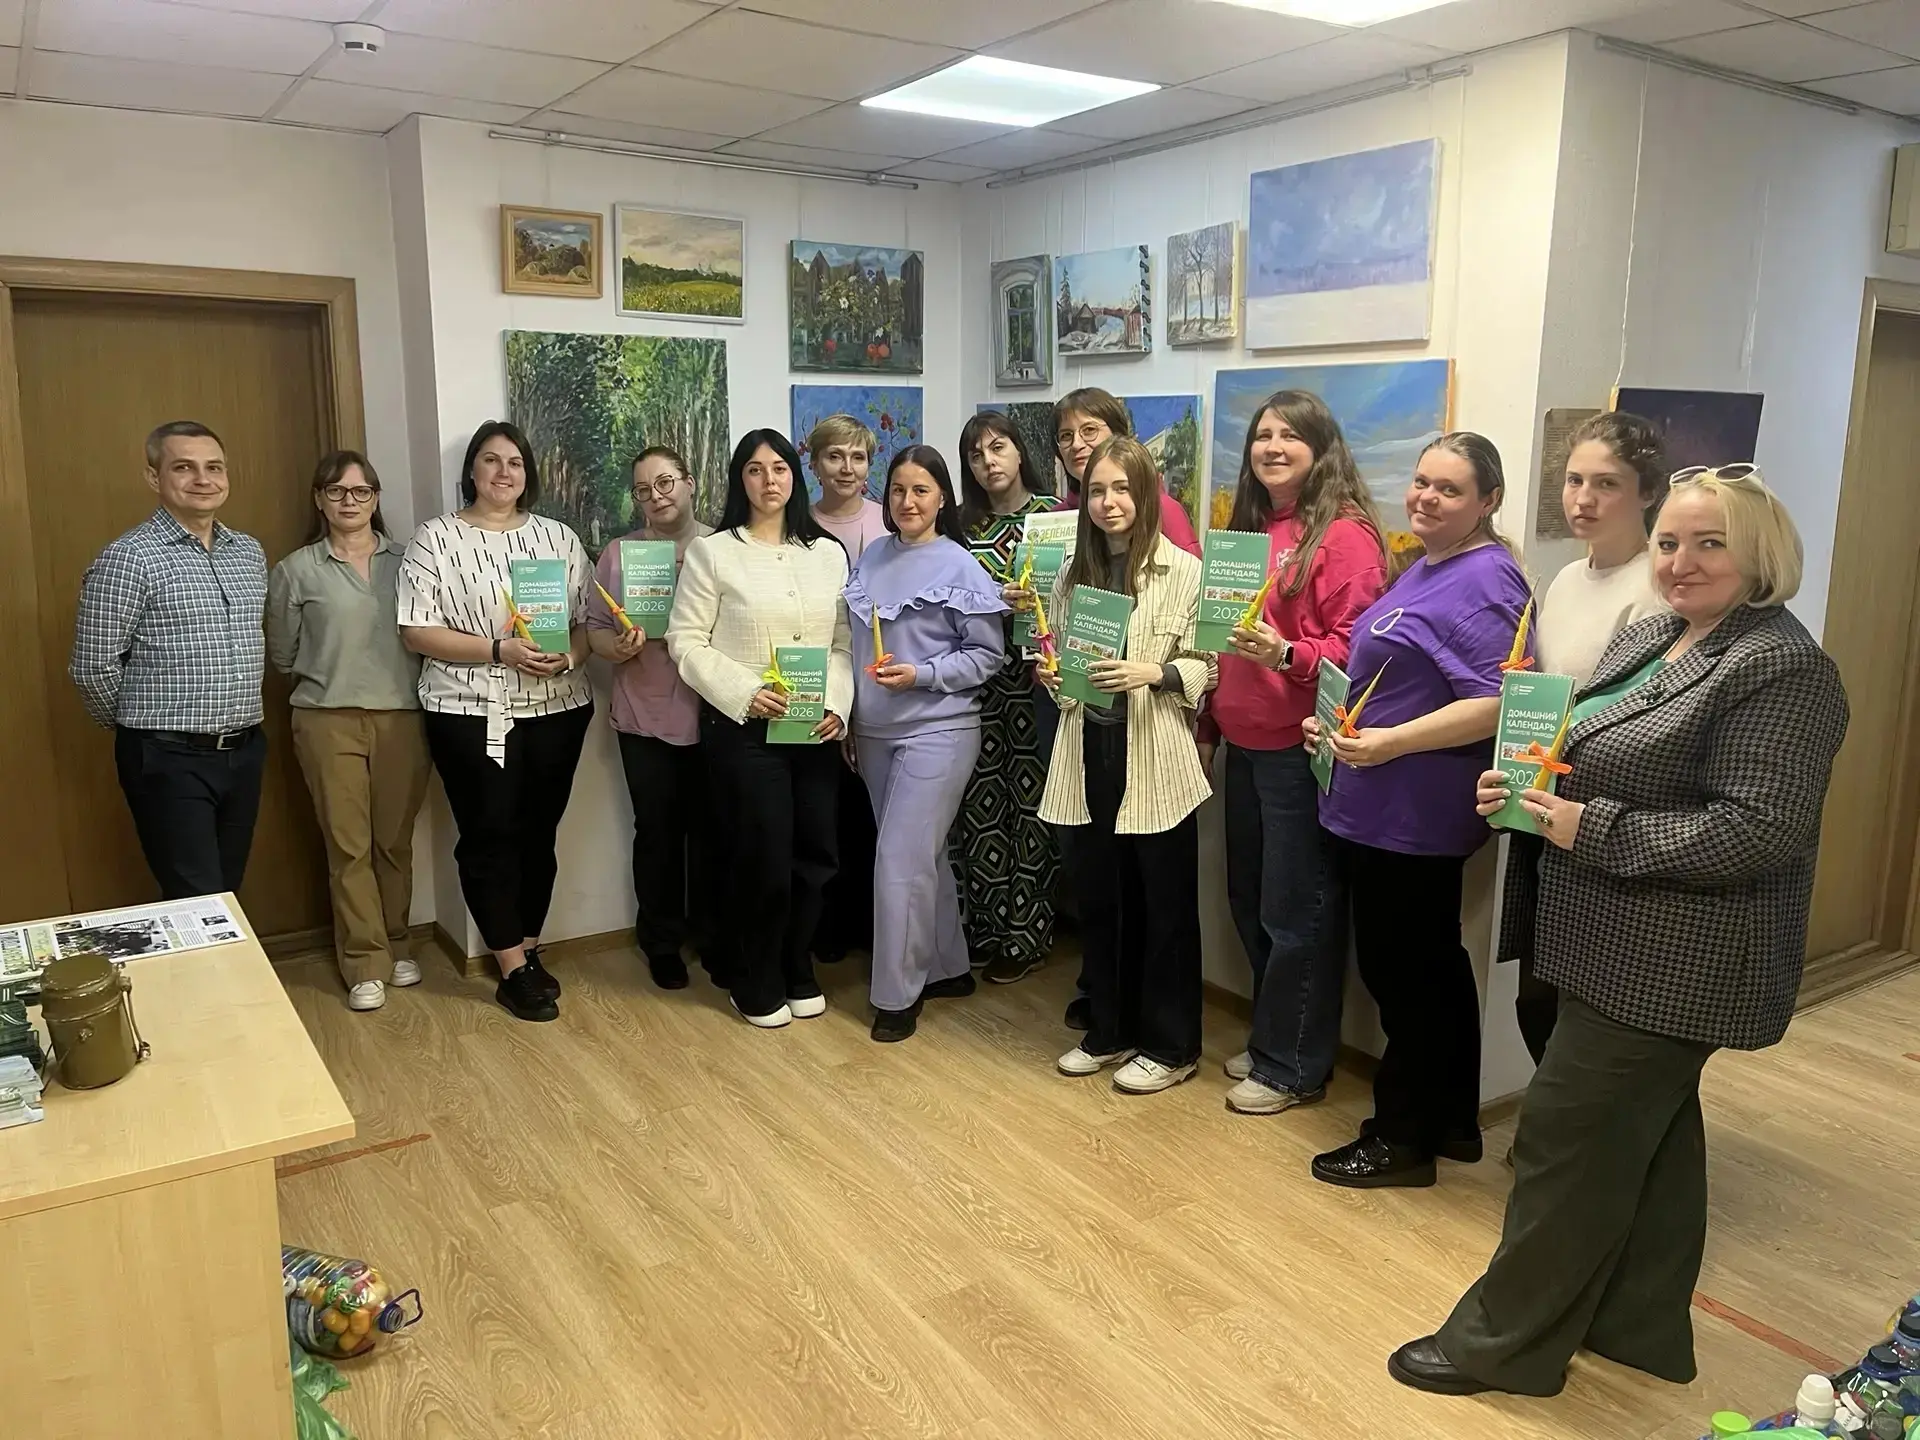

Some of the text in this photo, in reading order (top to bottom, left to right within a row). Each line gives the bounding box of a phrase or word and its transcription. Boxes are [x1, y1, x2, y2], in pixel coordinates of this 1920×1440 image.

[1209, 560, 1260, 570] ДОМАШНИЙ
[1209, 568, 1260, 578] КАЛЕНДАРЬ
[634, 600, 667, 612] 2026
[1075, 612, 1121, 630] ДОМАШНИЙ
[1073, 620, 1119, 637] КАЛЕНДАРЬ
[1507, 709, 1558, 721] ДОМАШНИЙ
[1506, 719, 1556, 731] КАЛЕНДАРЬ
